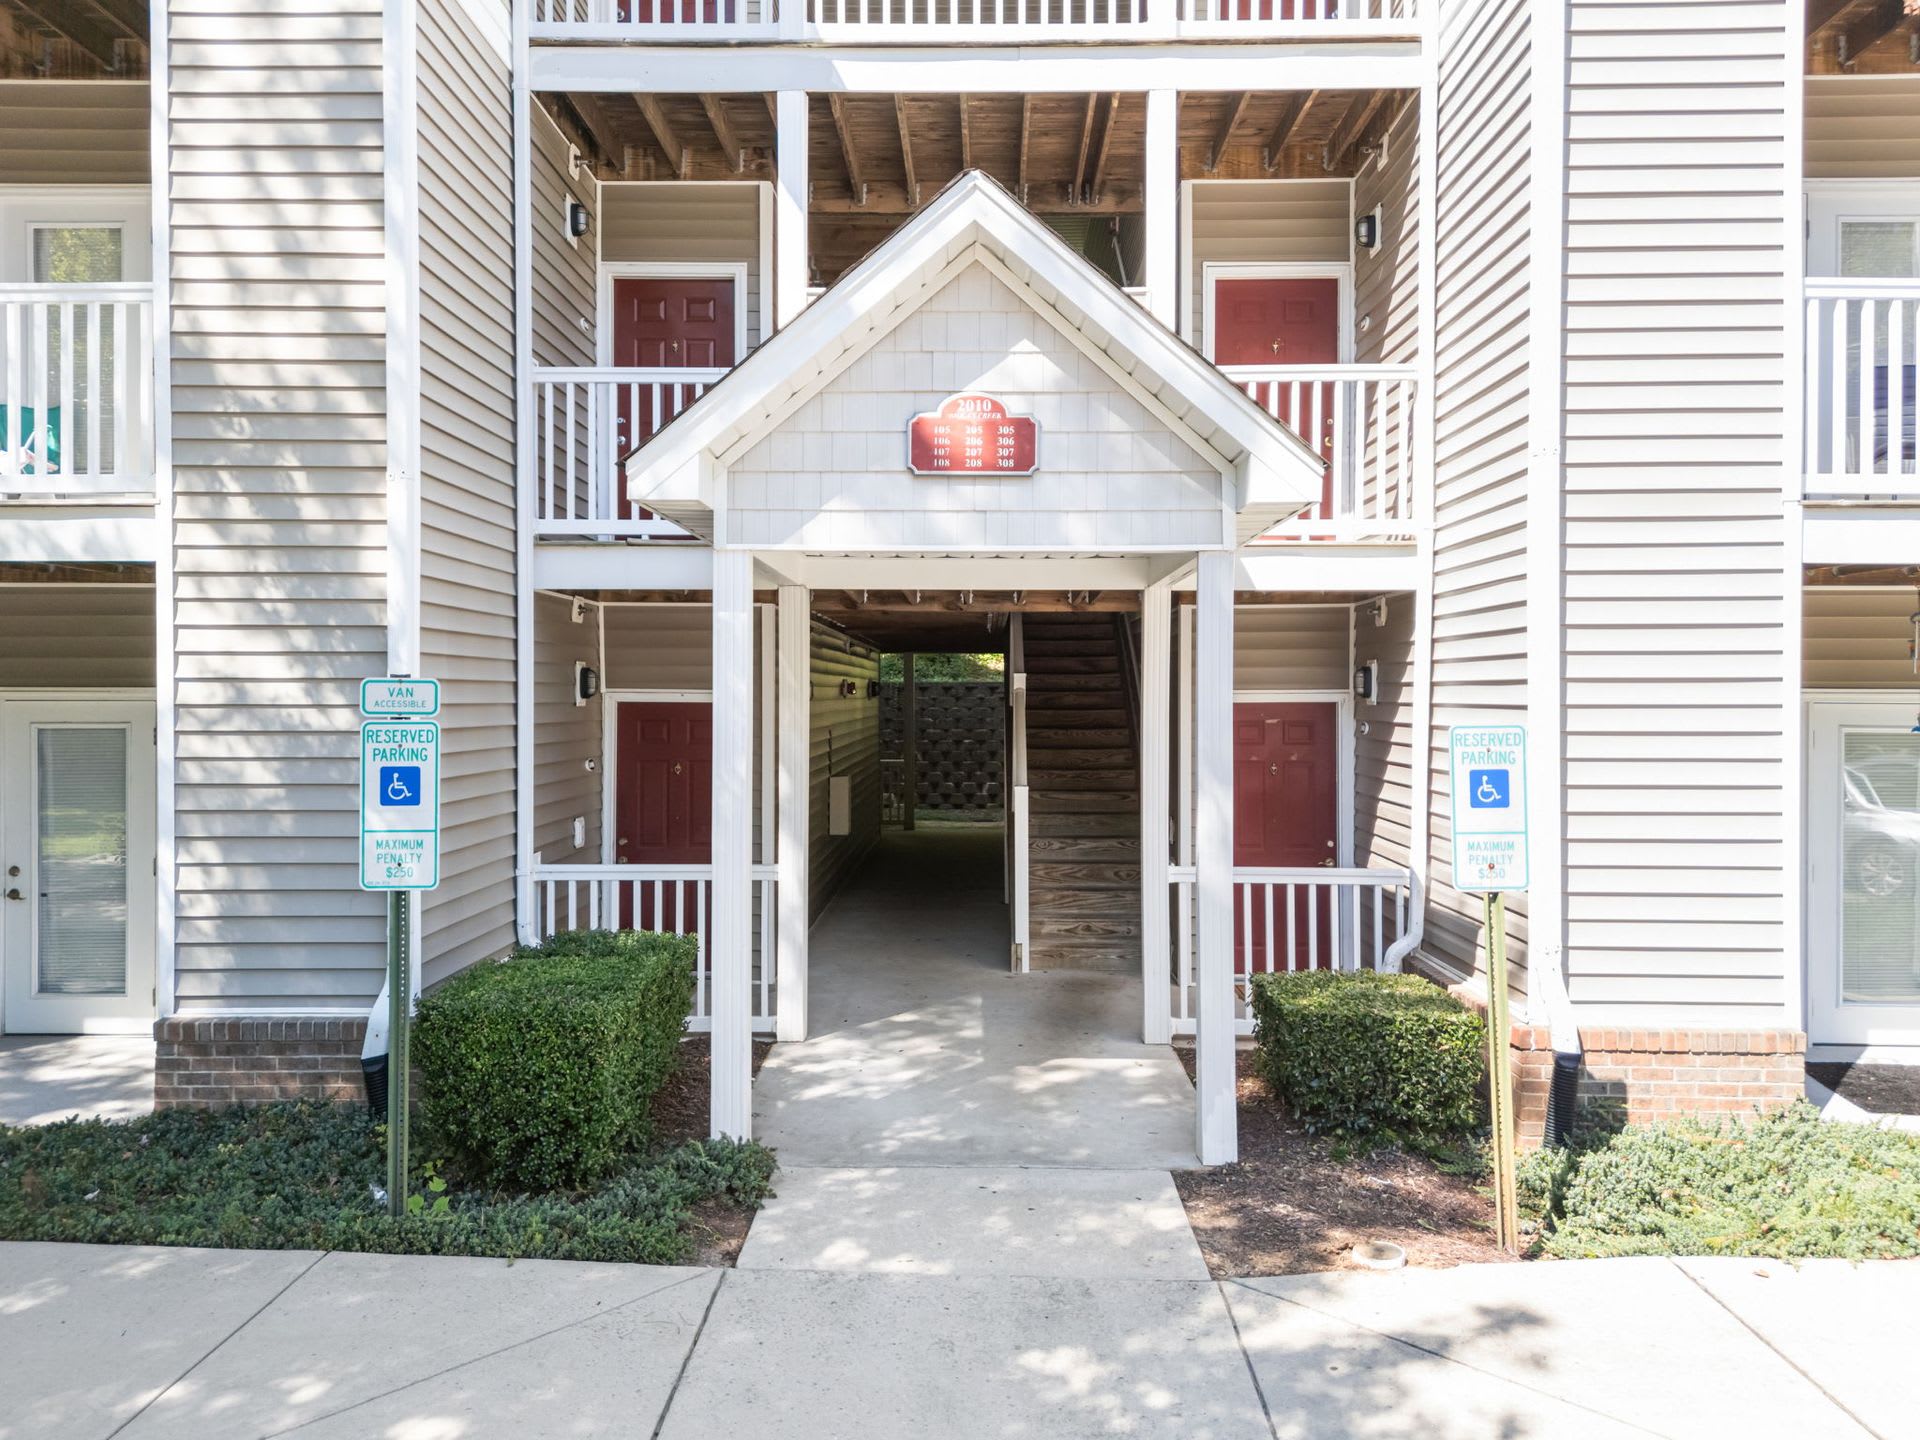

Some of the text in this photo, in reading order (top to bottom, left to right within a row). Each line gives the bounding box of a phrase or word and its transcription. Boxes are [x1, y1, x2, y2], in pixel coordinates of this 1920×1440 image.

[958, 400, 992, 412] 2010
[934, 426, 1015, 434] 105 205 305
[934, 437, 1015, 445] 106 206 306
[934, 448, 1015, 456] 107 207 307
[934, 459, 1015, 467] 108 208 308
[388, 687, 414, 698] VAN
[374, 700, 427, 708] ACCESSIBLE
[366, 729, 434, 744] RESERVED
[1455, 733, 1522, 747] RESERVED
[372, 747, 428, 762] PARKING
[1461, 751, 1516, 765] PARKING
[376, 839, 424, 850] MAXIMUM
[1467, 841, 1515, 851] MAXIMUM
[376, 853, 423, 864] PENALTY
[1469, 854, 1513, 865] PENALTY
[386, 866, 413, 878] $250
[1478, 868, 1506, 880] $250
